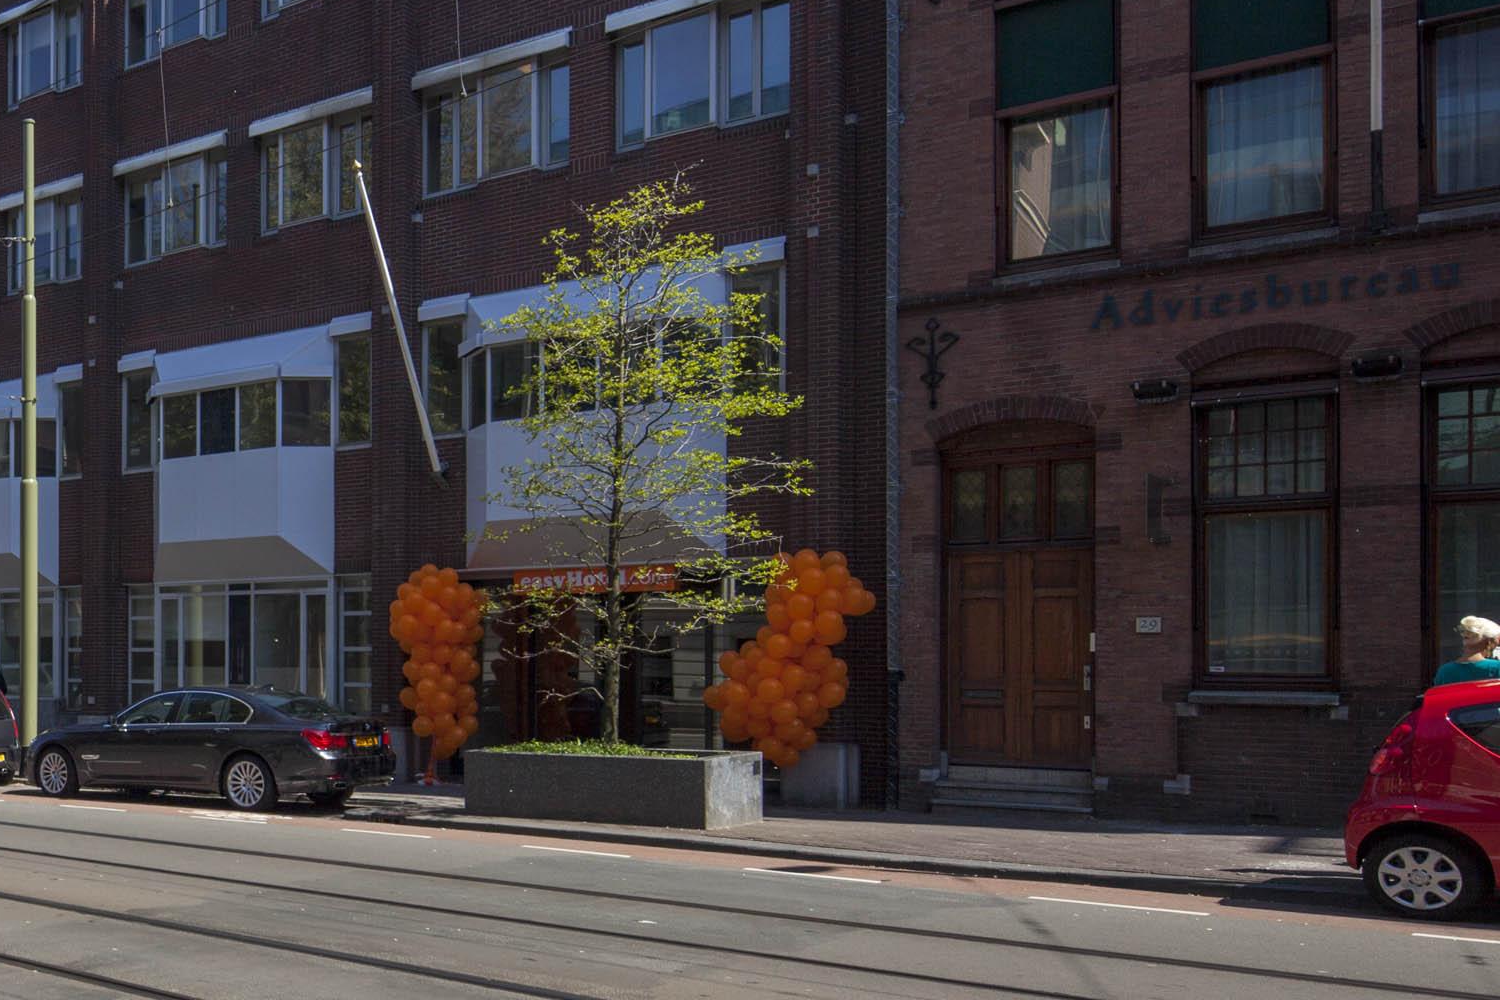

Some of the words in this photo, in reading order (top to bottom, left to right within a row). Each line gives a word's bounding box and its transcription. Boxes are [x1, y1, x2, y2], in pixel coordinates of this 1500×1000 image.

[1091, 262, 1462, 331] Adviesbureau
[520, 567, 669, 591] easyHotl.com
[1139, 619, 1157, 631] 29
